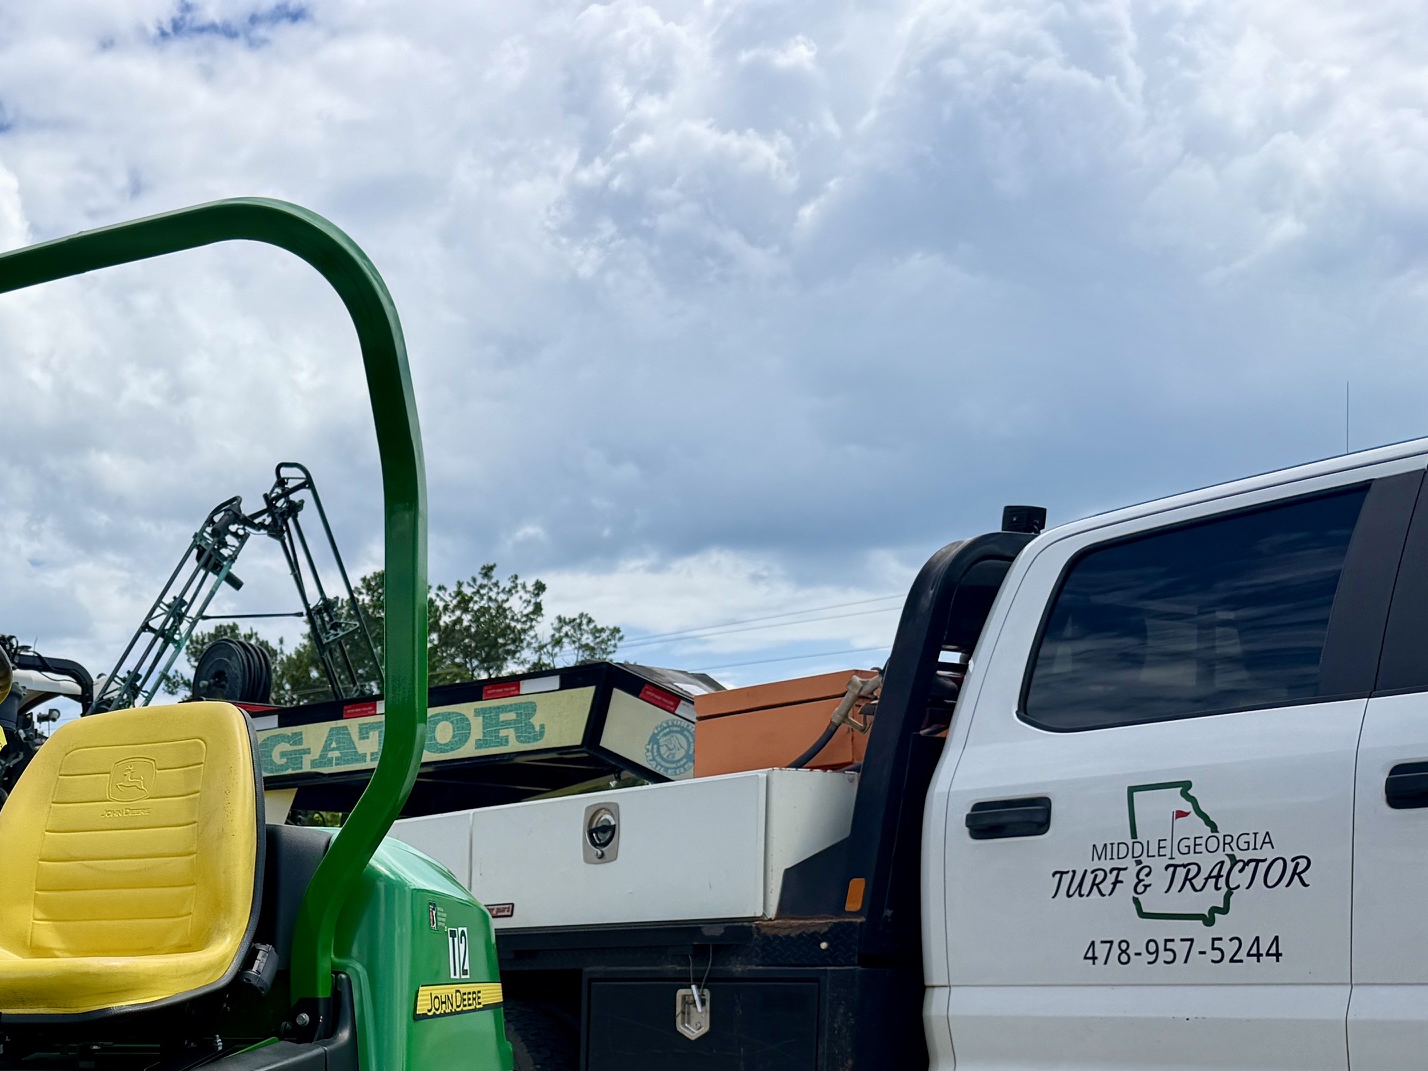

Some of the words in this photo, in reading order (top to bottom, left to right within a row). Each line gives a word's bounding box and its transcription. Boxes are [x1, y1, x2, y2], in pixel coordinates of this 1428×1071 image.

[1090, 838, 1168, 862] MIDDLE
[1176, 831, 1275, 856] GEORGIA
[1050, 866, 1128, 899] TURF
[1133, 864, 1153, 896] &
[1163, 855, 1312, 895] TRACTOR
[1083, 935, 1283, 966] 478-957-5244
[427, 992, 454, 1013] JOHN
[455, 989, 482, 1009] DEERE
